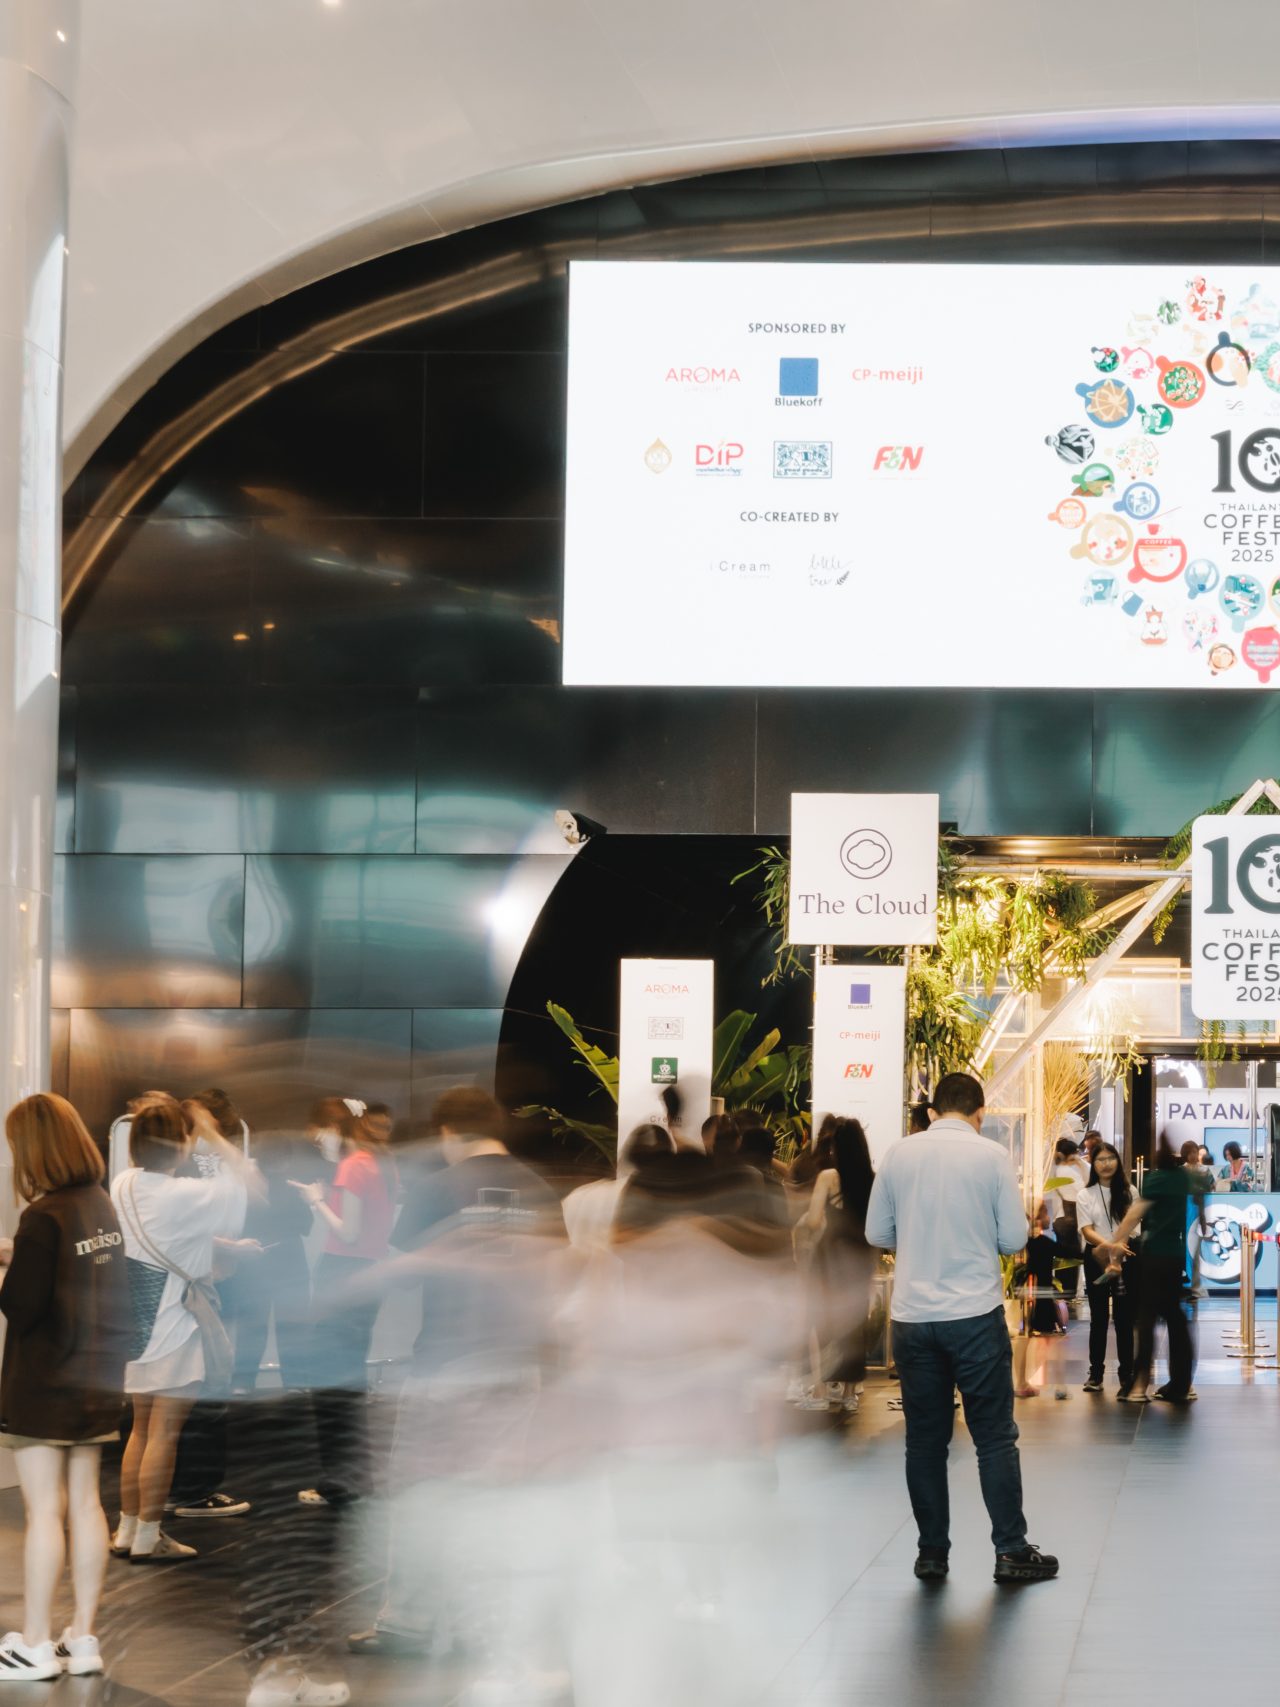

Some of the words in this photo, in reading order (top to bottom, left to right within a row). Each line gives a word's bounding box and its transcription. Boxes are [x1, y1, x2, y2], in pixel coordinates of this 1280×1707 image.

[748, 322, 827, 334] SPONSORED
[830, 323, 846, 334] BY
[664, 366, 741, 384] AROMA
[851, 366, 924, 385] CP-meiji
[774, 396, 823, 407] Bluekoff
[739, 511, 820, 523] CO-CREATED
[823, 511, 839, 523] BY
[1231, 548, 1275, 563] 2025
[798, 892, 845, 915] The
[855, 892, 929, 916] Cloud
[644, 983, 690, 994] AROMA
[839, 1030, 882, 1042] CP-meiji
[1167, 1103, 1261, 1120] PATANA
